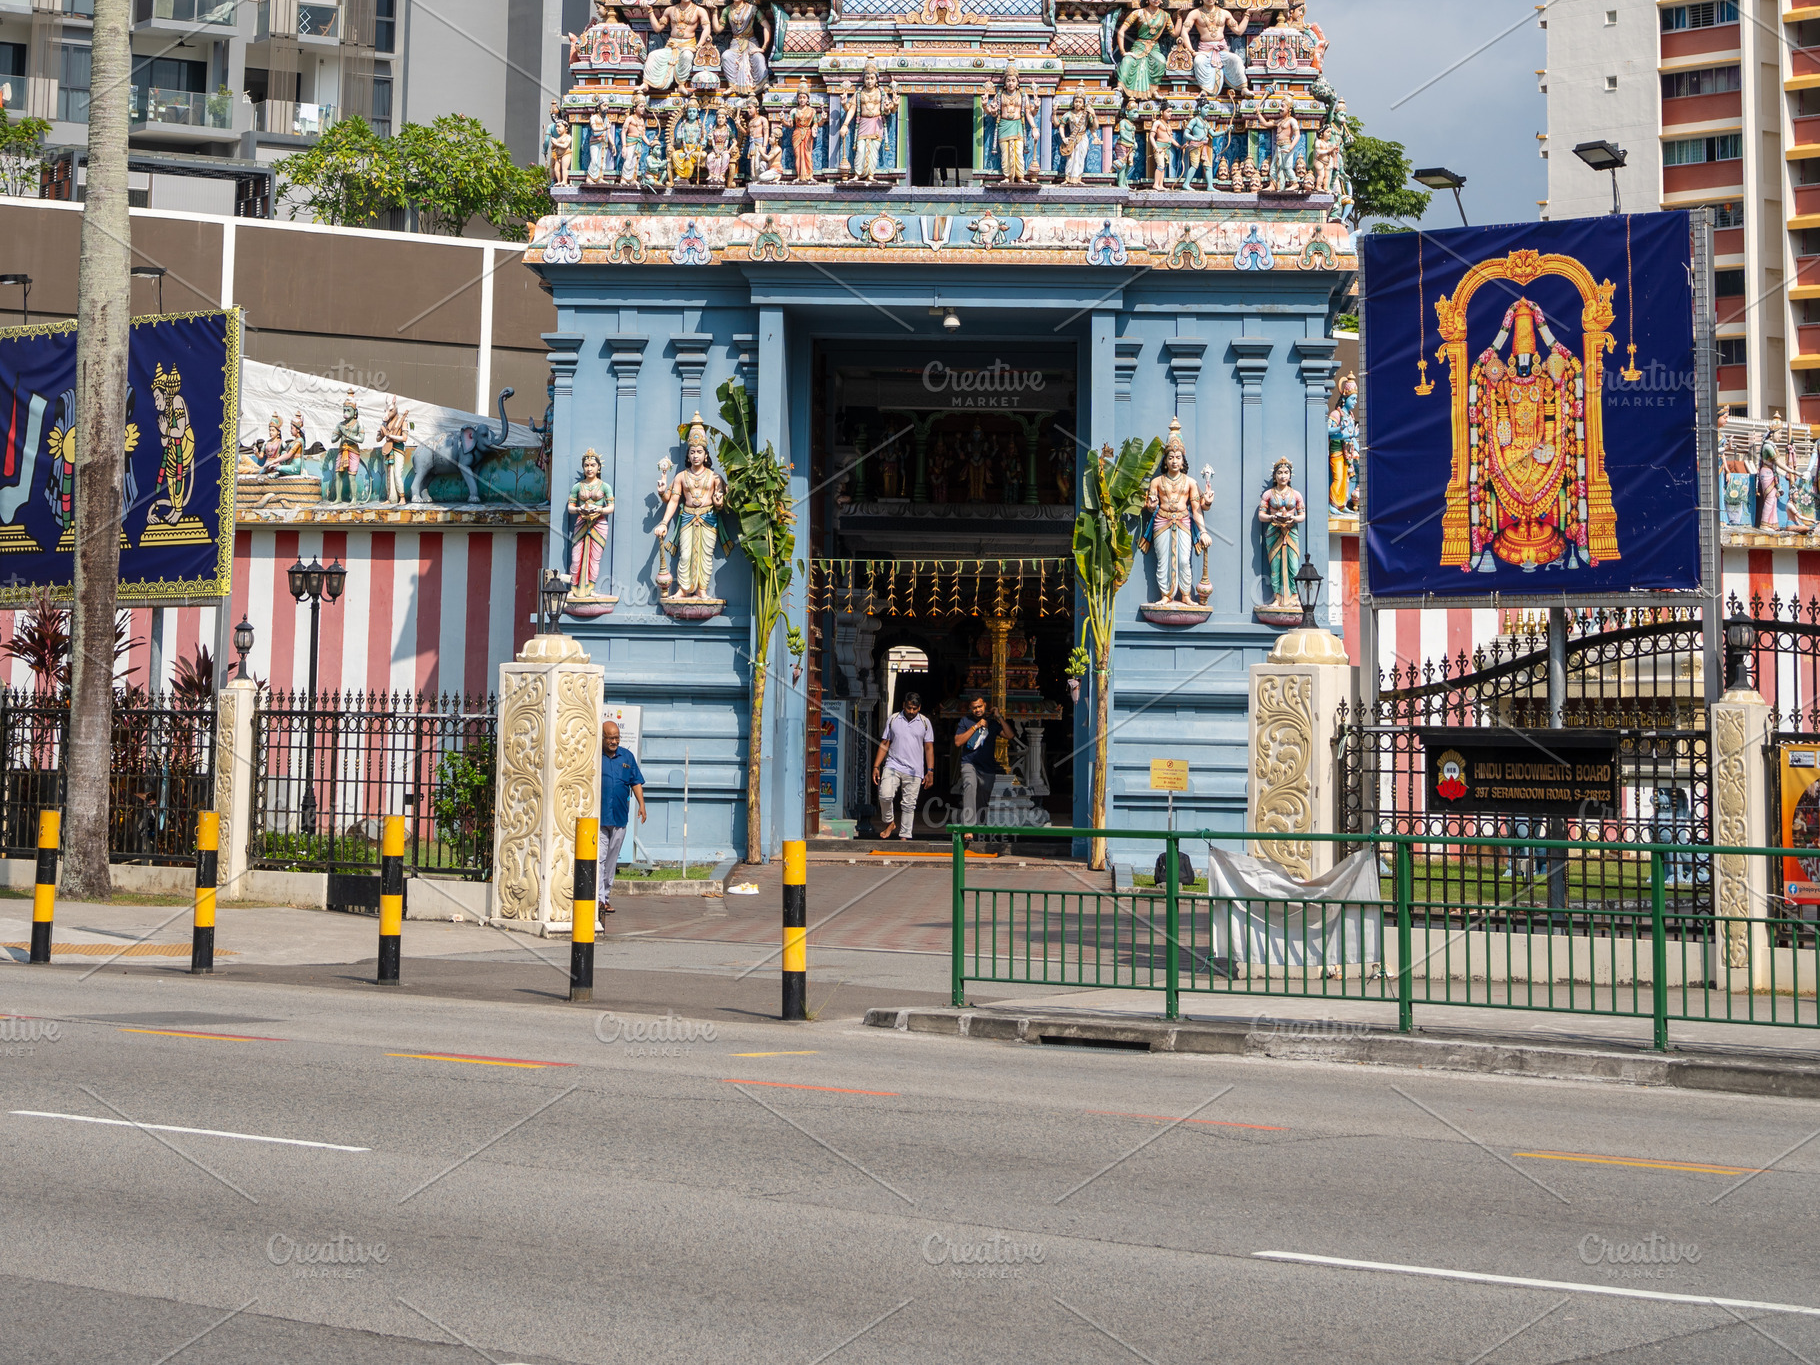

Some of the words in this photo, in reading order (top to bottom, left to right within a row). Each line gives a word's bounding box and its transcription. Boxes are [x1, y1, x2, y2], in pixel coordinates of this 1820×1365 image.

[1474, 762, 1502, 780] HINDU
[1505, 763, 1572, 780] ENDOWMENTS
[1576, 764, 1611, 782] BOARD
[1474, 787, 1489, 798] 397
[1491, 787, 1545, 800] SERANGOON
[1546, 788, 1572, 802] ROAD,
